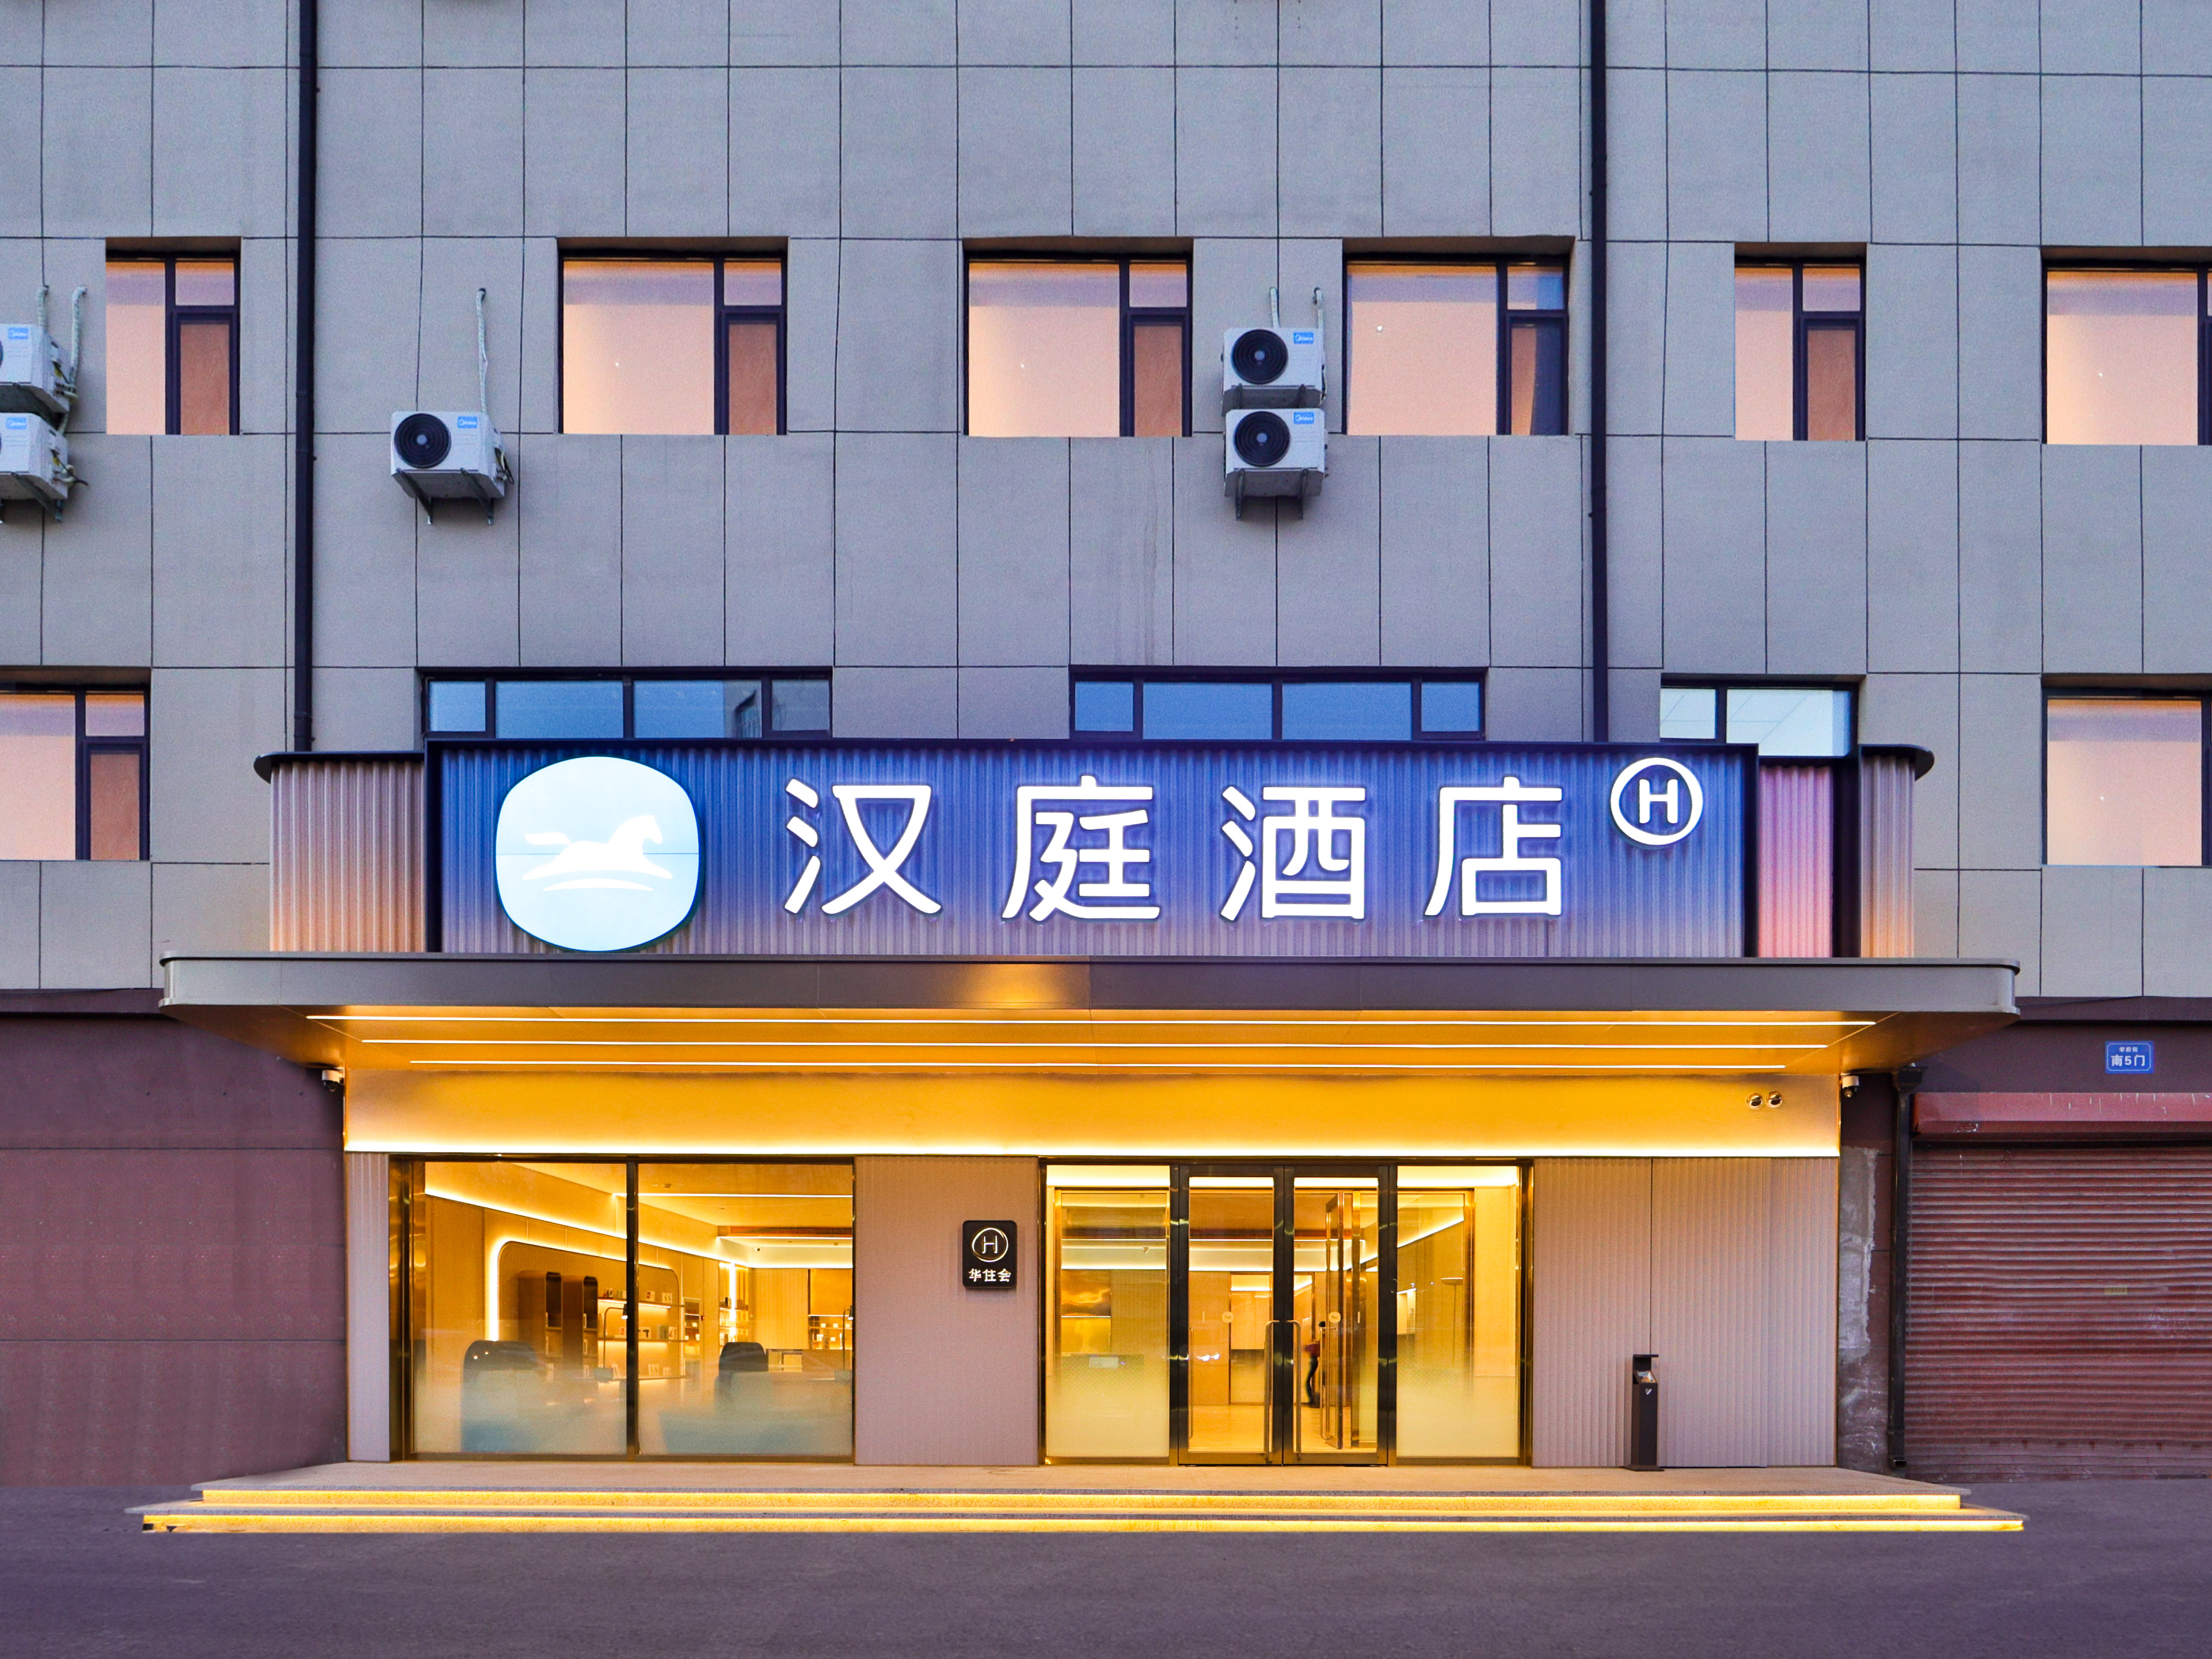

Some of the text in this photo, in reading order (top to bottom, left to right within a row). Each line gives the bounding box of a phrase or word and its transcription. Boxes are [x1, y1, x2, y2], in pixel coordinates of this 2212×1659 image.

[784, 775, 1562, 922] 汉庭酒店
[2111, 1054, 2145, 1067] 南5门
[969, 1268, 1011, 1283] 华住会
